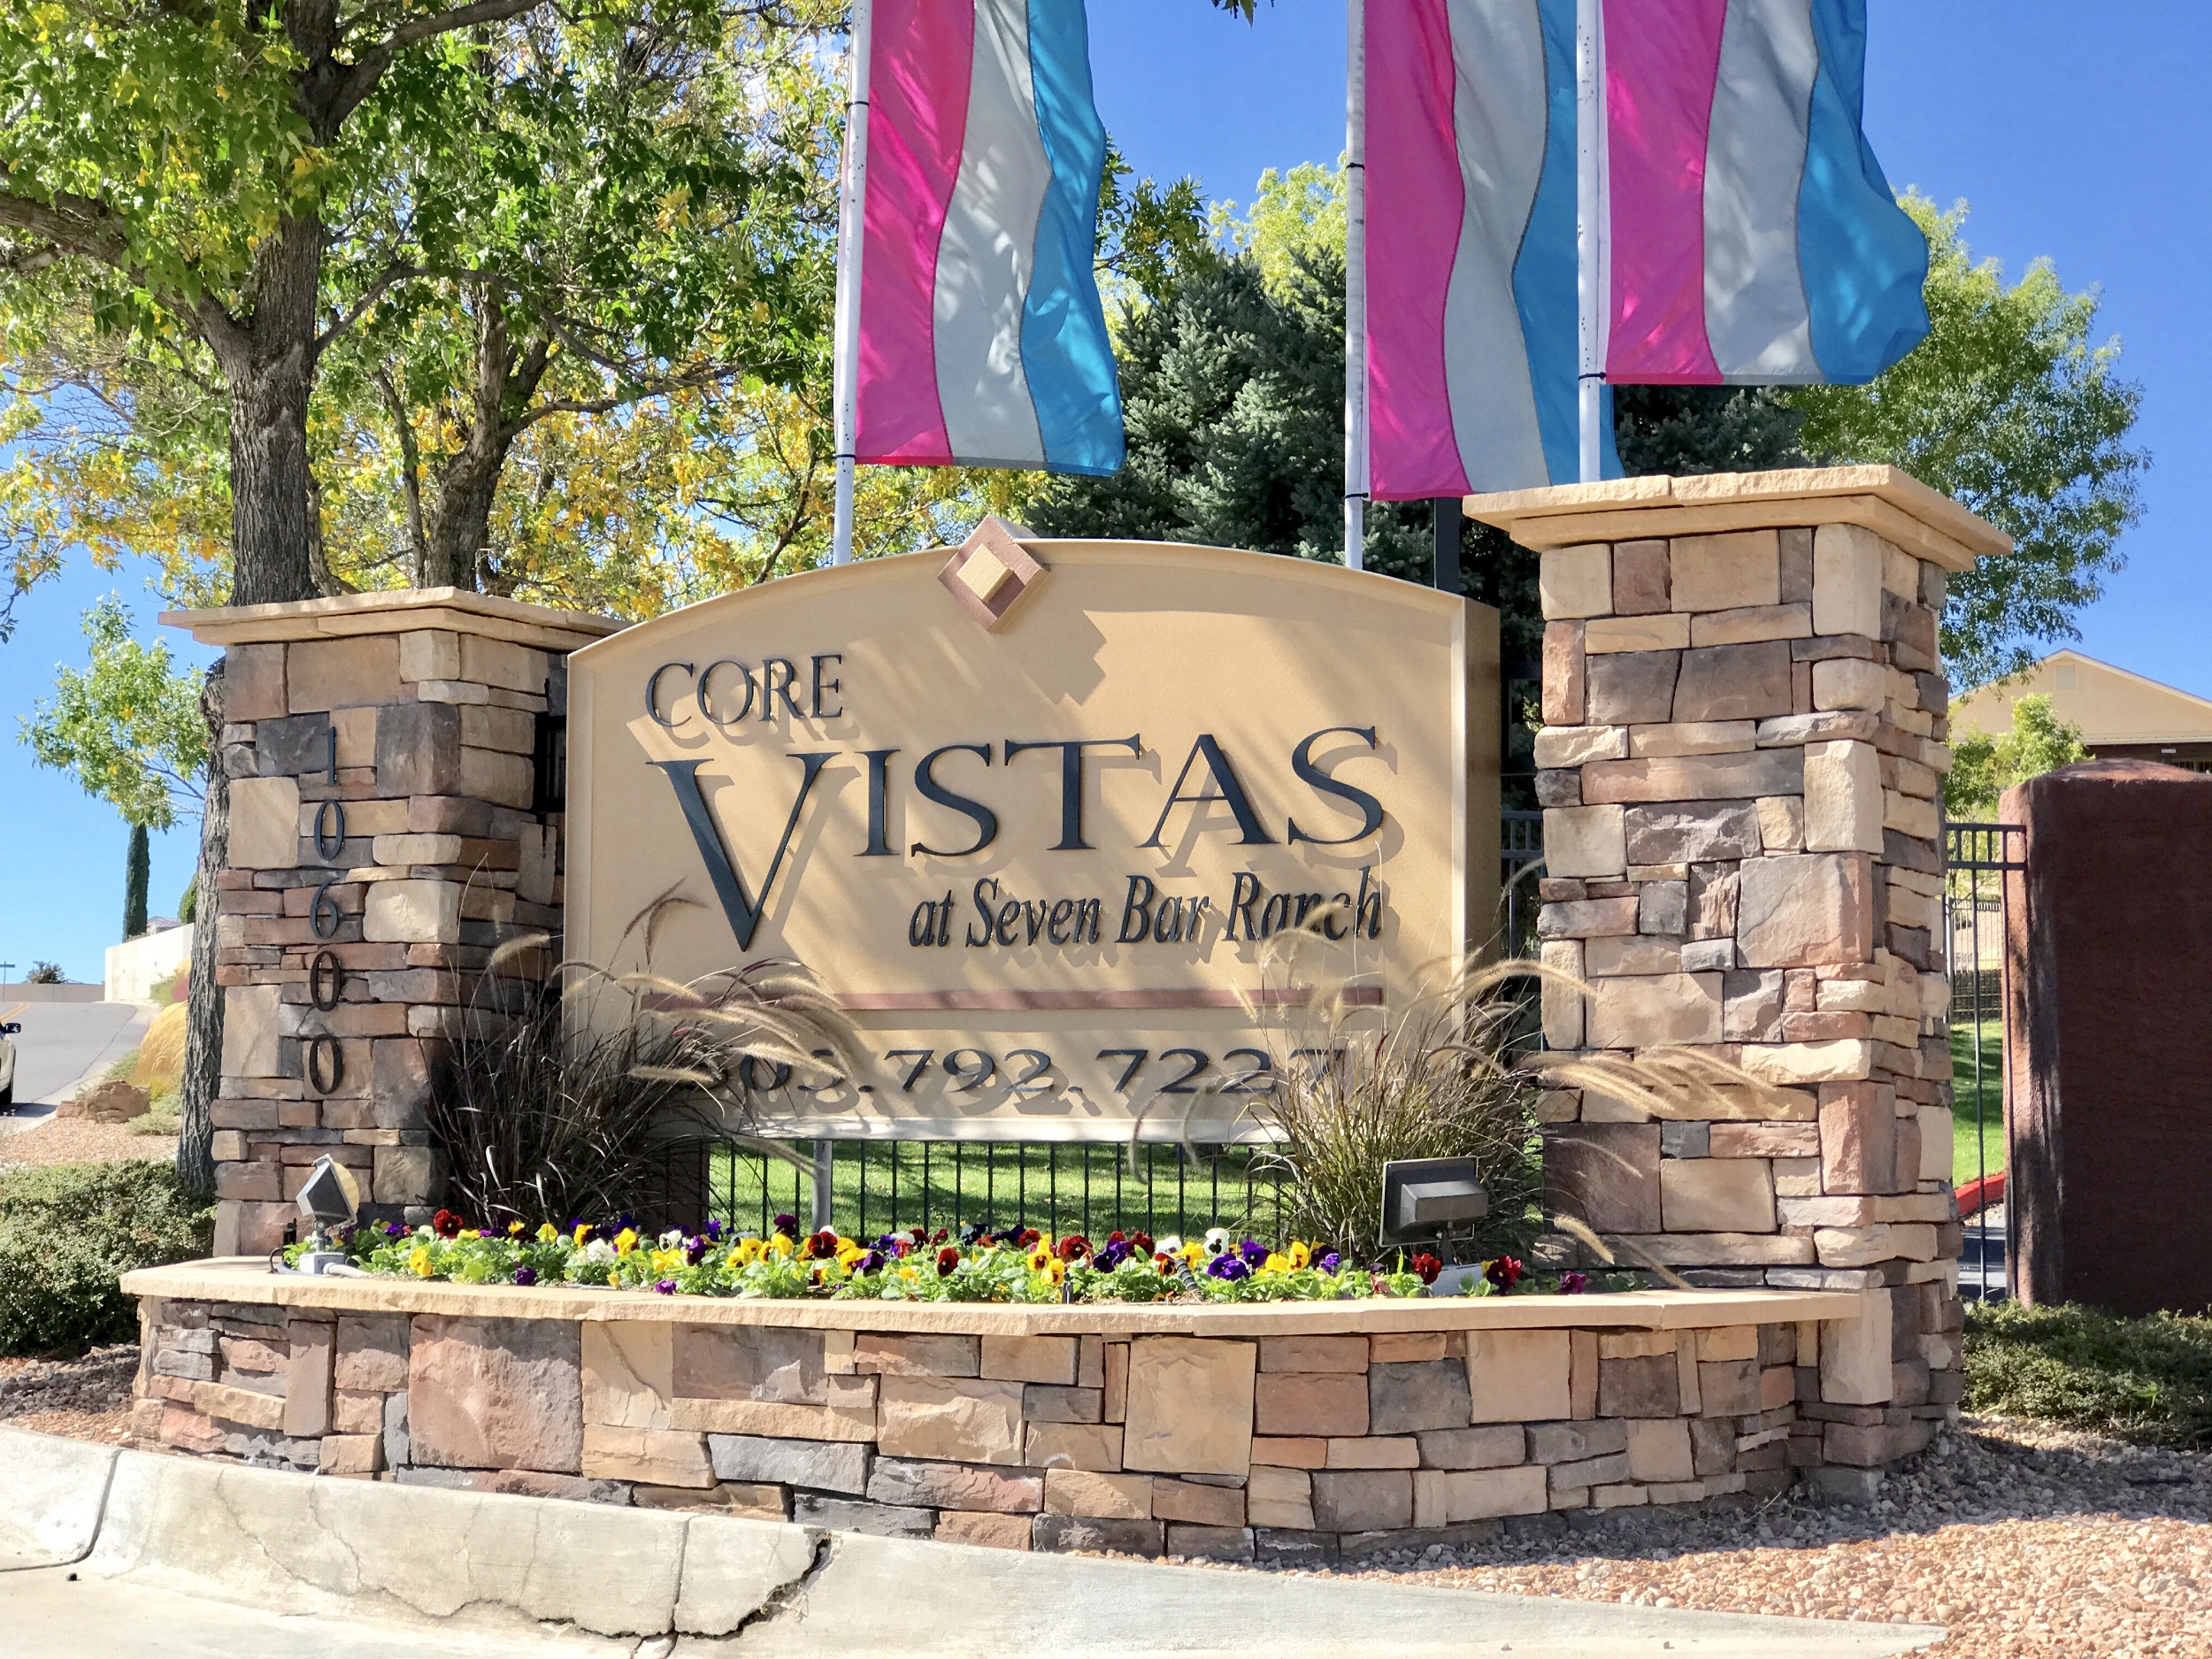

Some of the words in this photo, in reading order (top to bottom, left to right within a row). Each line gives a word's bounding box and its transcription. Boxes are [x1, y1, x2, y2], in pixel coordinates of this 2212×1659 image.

[646, 654, 843, 728] CORE
[645, 726, 1386, 951] VISTAS
[310, 726, 345, 1095] 10600
[909, 888, 953, 948] at
[965, 877, 1102, 948] Seven
[1114, 874, 1209, 944] Bar
[1221, 865, 1381, 941] Ranch
[685, 1048, 1345, 1093] 0.792.7227
